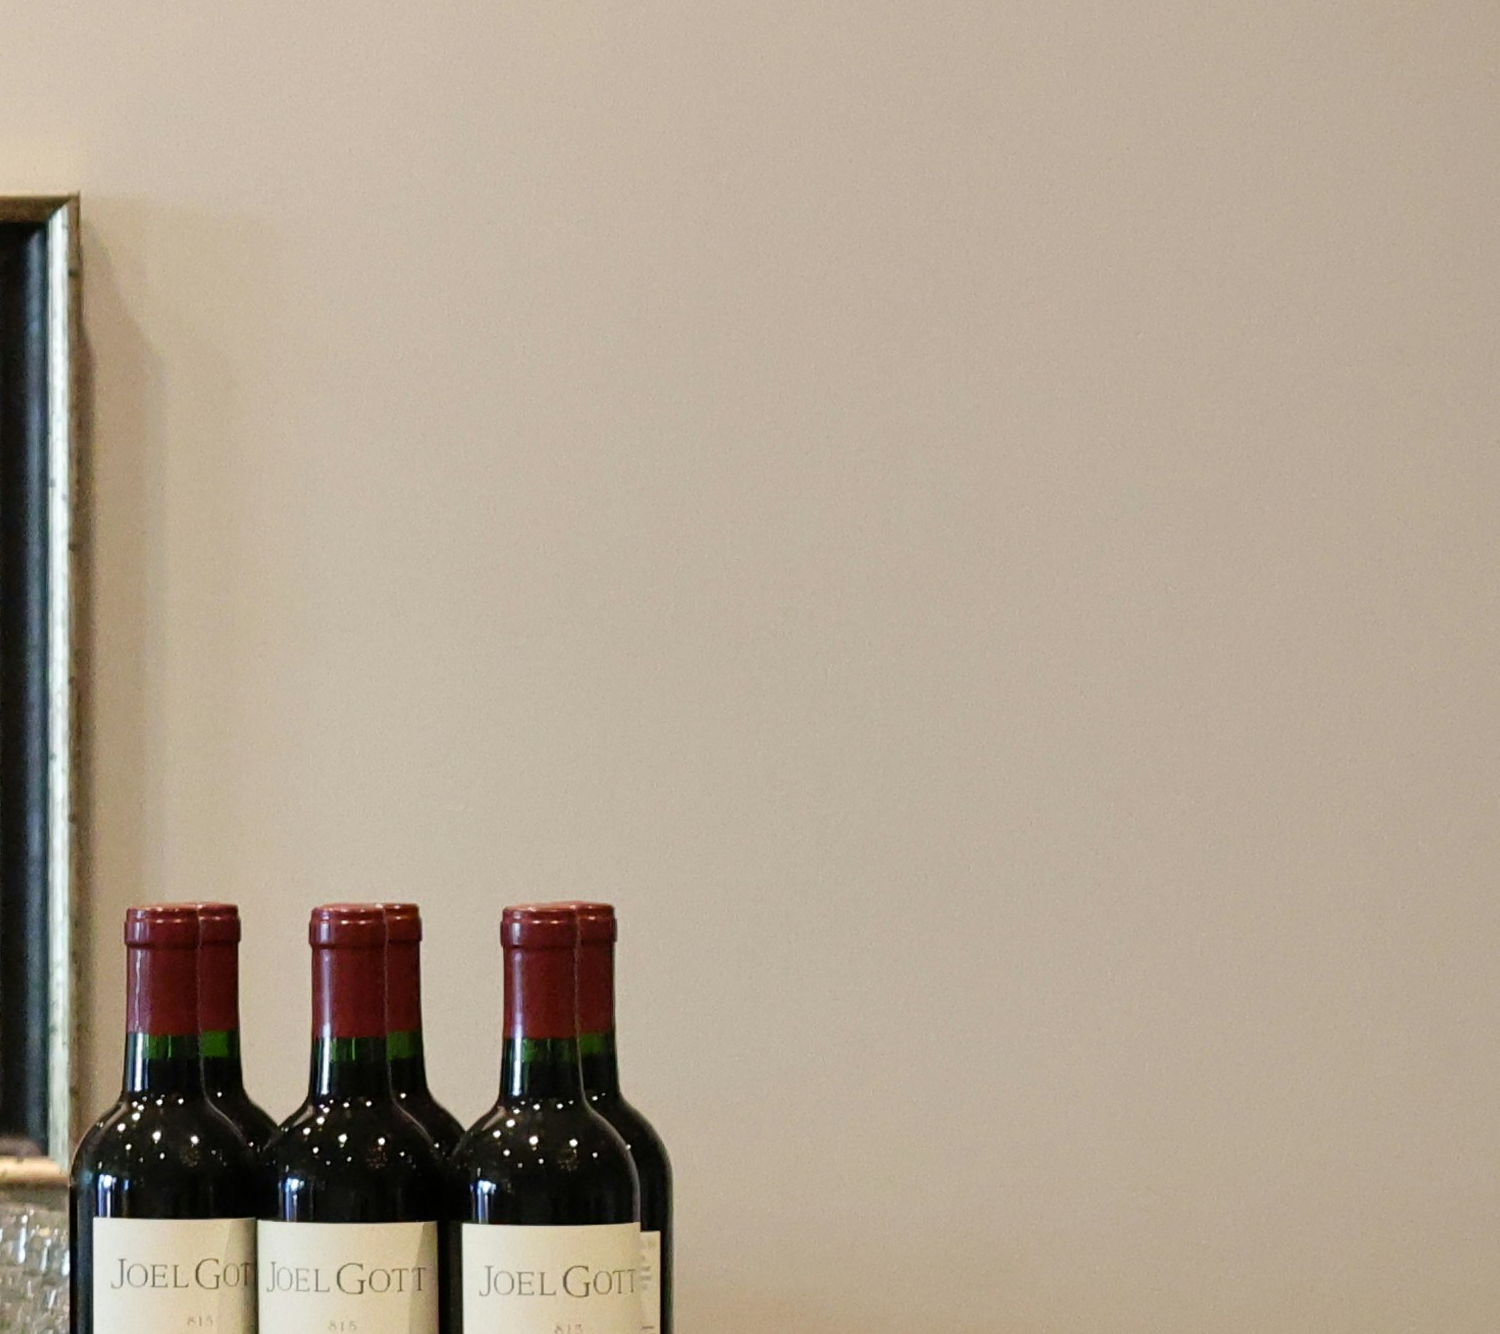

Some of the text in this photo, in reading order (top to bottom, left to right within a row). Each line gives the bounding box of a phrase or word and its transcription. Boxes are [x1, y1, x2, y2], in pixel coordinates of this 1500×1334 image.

[111, 1258, 190, 1290] JOEL
[267, 1262, 427, 1295] JOEL GOTT
[479, 1266, 556, 1297] JOEL
